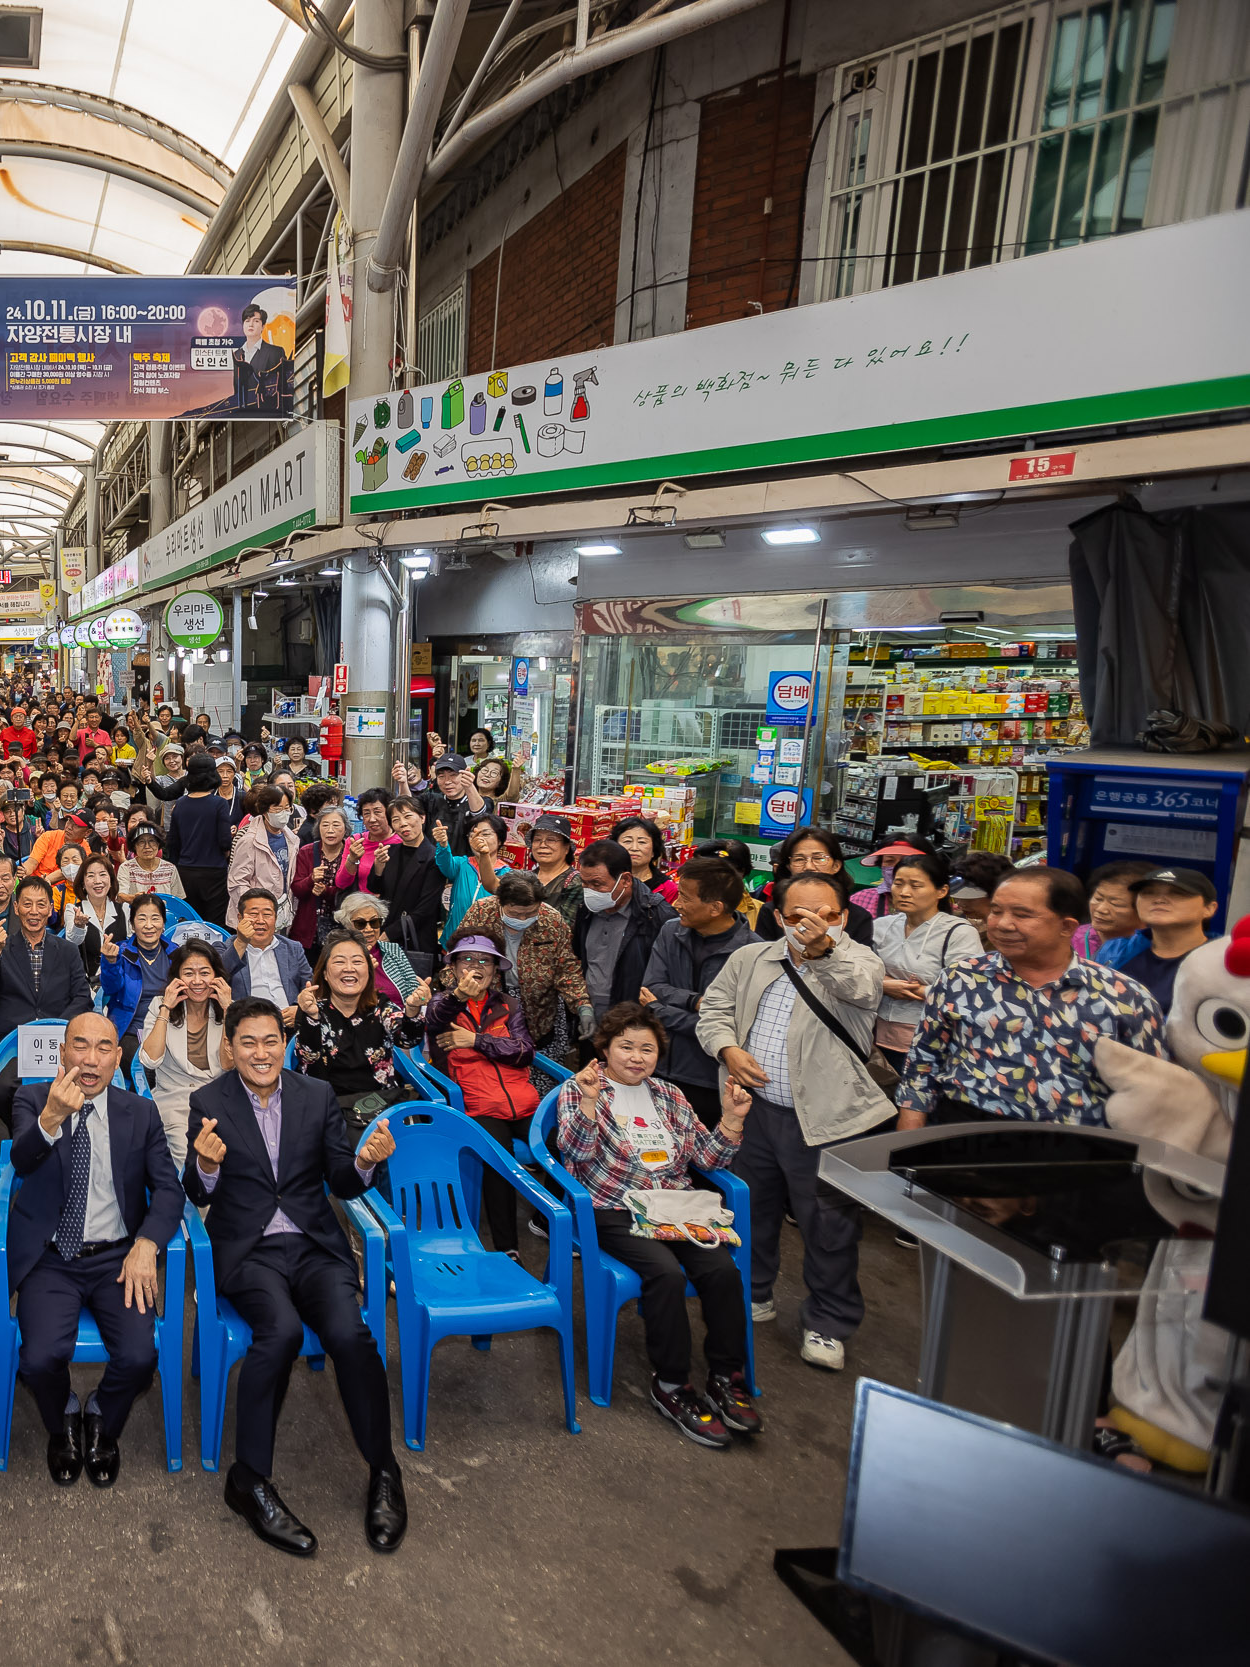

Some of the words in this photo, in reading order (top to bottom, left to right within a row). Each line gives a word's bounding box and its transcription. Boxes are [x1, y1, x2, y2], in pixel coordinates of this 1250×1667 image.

[101, 305, 186, 320] 16:00~20:00
[6, 326, 112, 344] 자양전통시장
[116, 326, 132, 344] 내
[10, 353, 28, 363] 고객
[30, 353, 47, 363] 감사
[633, 383, 689, 409] 상품의
[779, 358, 821, 385] 뭐든
[833, 357, 854, 370] 다
[1026, 457, 1050, 473] 15
[213, 485, 253, 539] WOORI
[260, 450, 306, 516] MART
[172, 604, 215, 617] 우리마트
[184, 618, 205, 631] 생선
[778, 685, 810, 699] 담배
